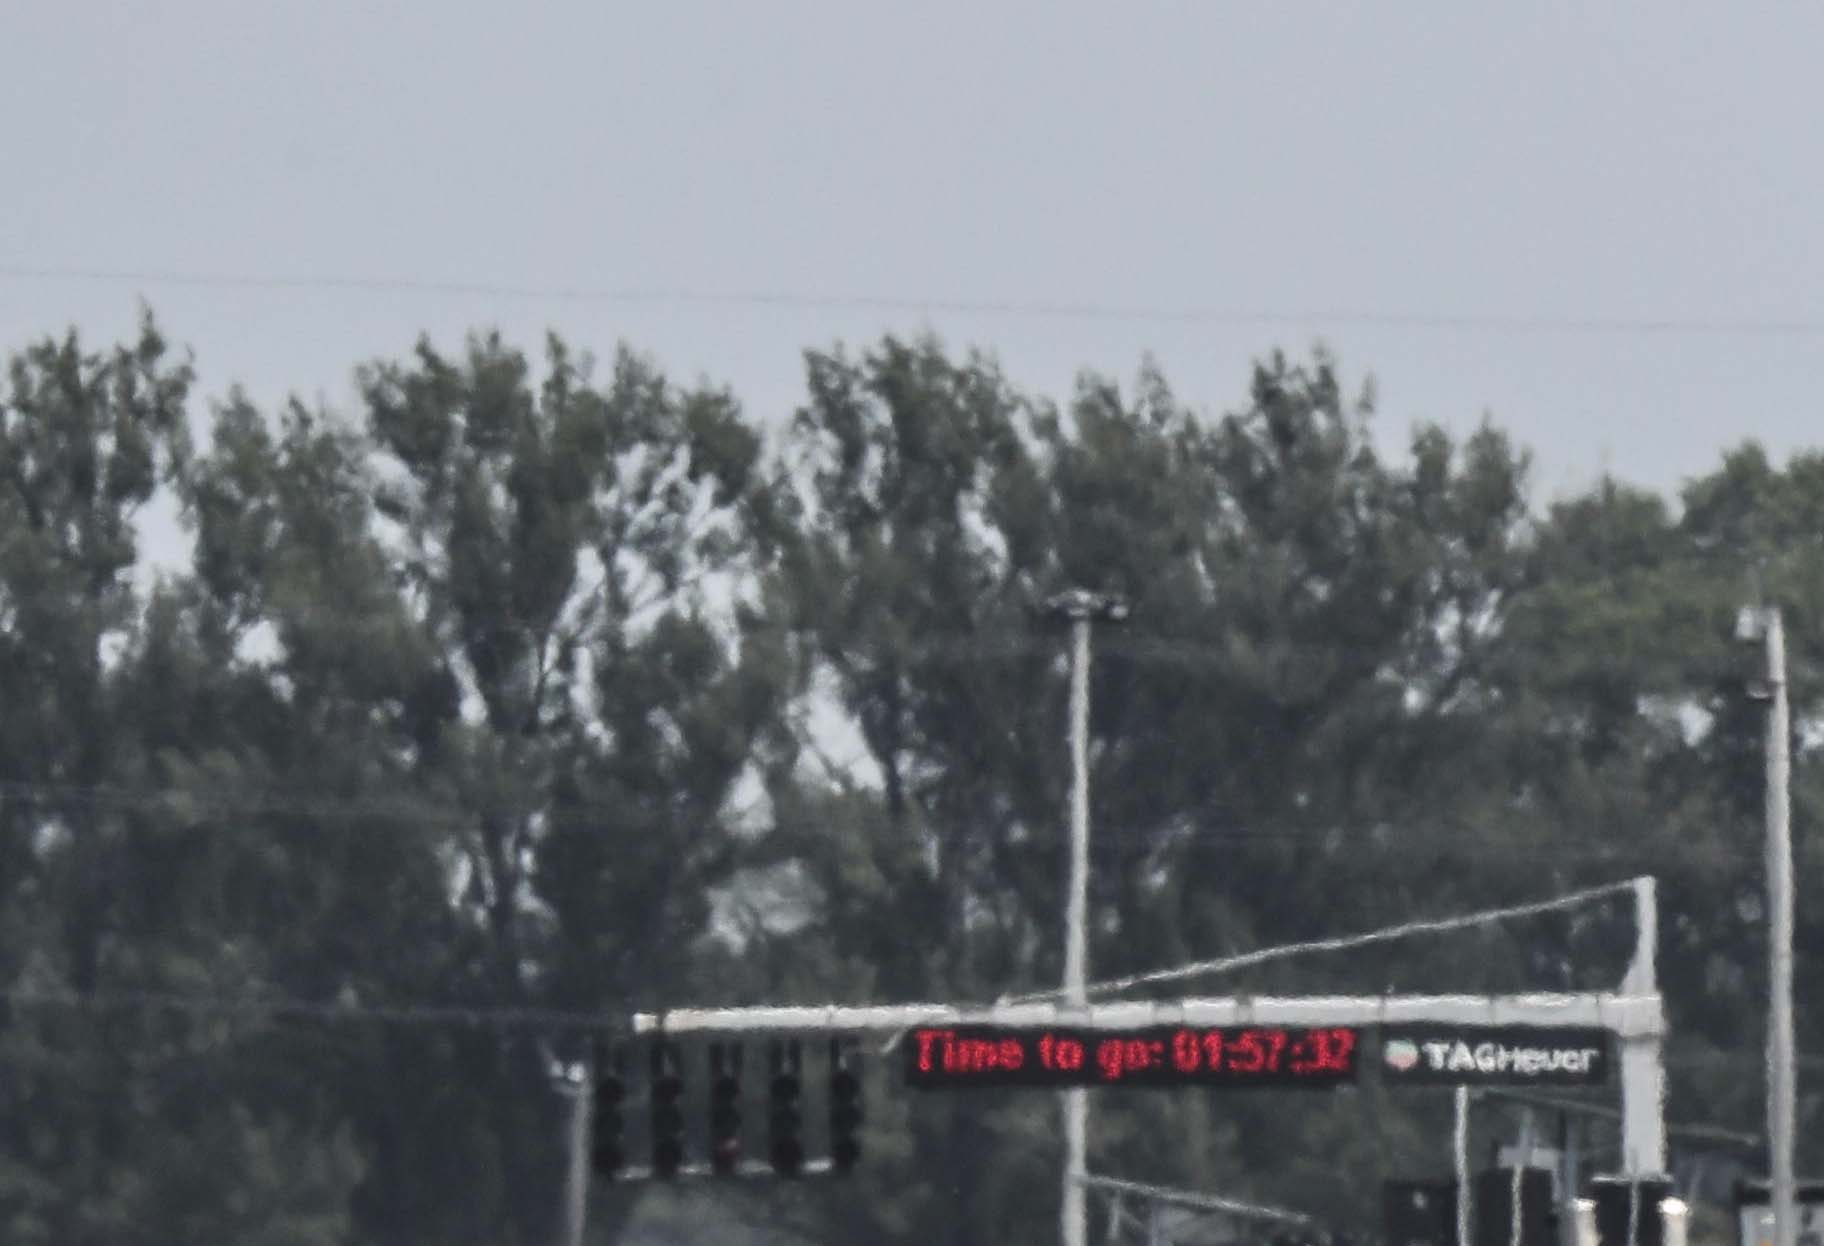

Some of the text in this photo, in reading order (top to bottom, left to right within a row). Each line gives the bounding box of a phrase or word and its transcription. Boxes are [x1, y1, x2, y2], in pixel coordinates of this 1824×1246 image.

[914, 1028, 1024, 1072] Time
[1039, 1033, 1085, 1070] to
[1097, 1038, 1164, 1080] go:
